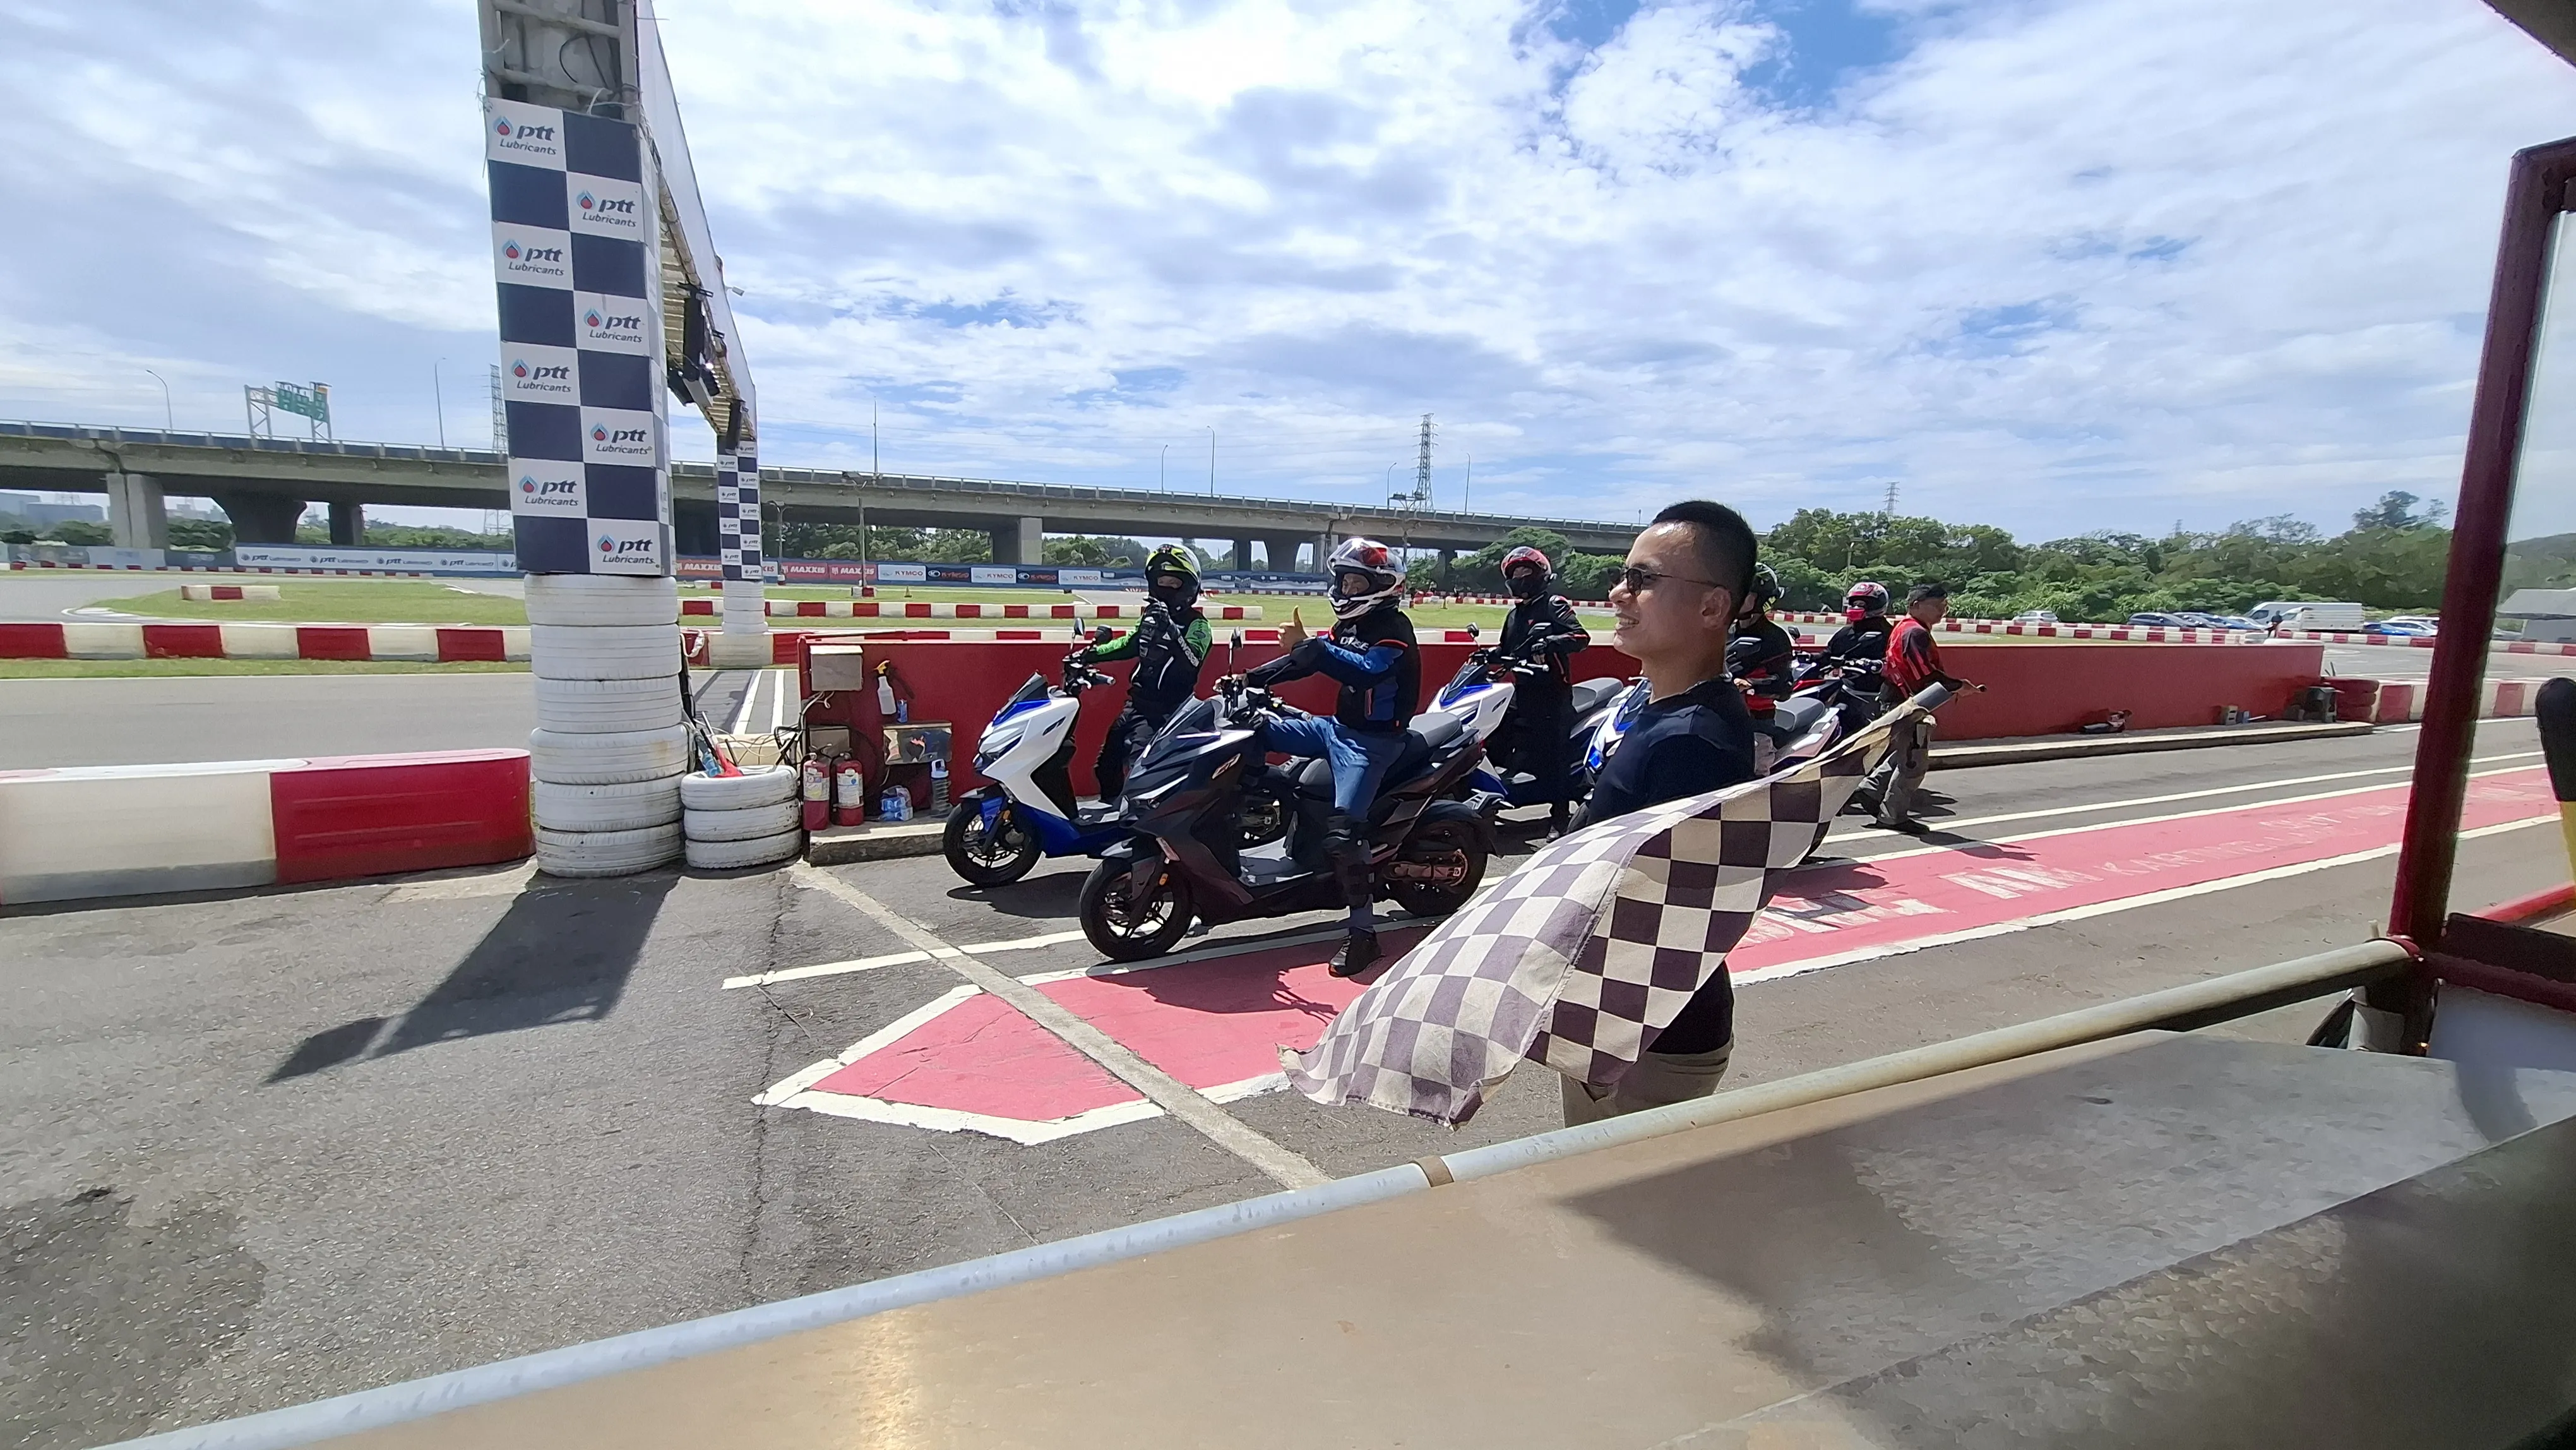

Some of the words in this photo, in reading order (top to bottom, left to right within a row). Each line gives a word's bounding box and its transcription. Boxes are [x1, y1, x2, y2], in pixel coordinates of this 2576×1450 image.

[516, 125, 555, 141] ptt
[499, 138, 557, 155] Lubricants
[599, 199, 636, 214] ptt
[582, 212, 636, 227] Lubricants
[525, 248, 563, 263] ptt
[508, 262, 564, 276] Lubricants
[605, 316, 641, 330] ptt
[590, 329, 643, 343] Lubricants
[532, 366, 570, 380] ptt
[516, 380, 571, 393] Lubricants
[611, 429, 647, 443] ptt
[596, 443, 648, 455] Lubricants
[540, 480, 577, 494] ptt
[525, 496, 579, 506] Lubricants
[618, 539, 653, 553] ptt
[602, 555, 655, 565] Lubricants
